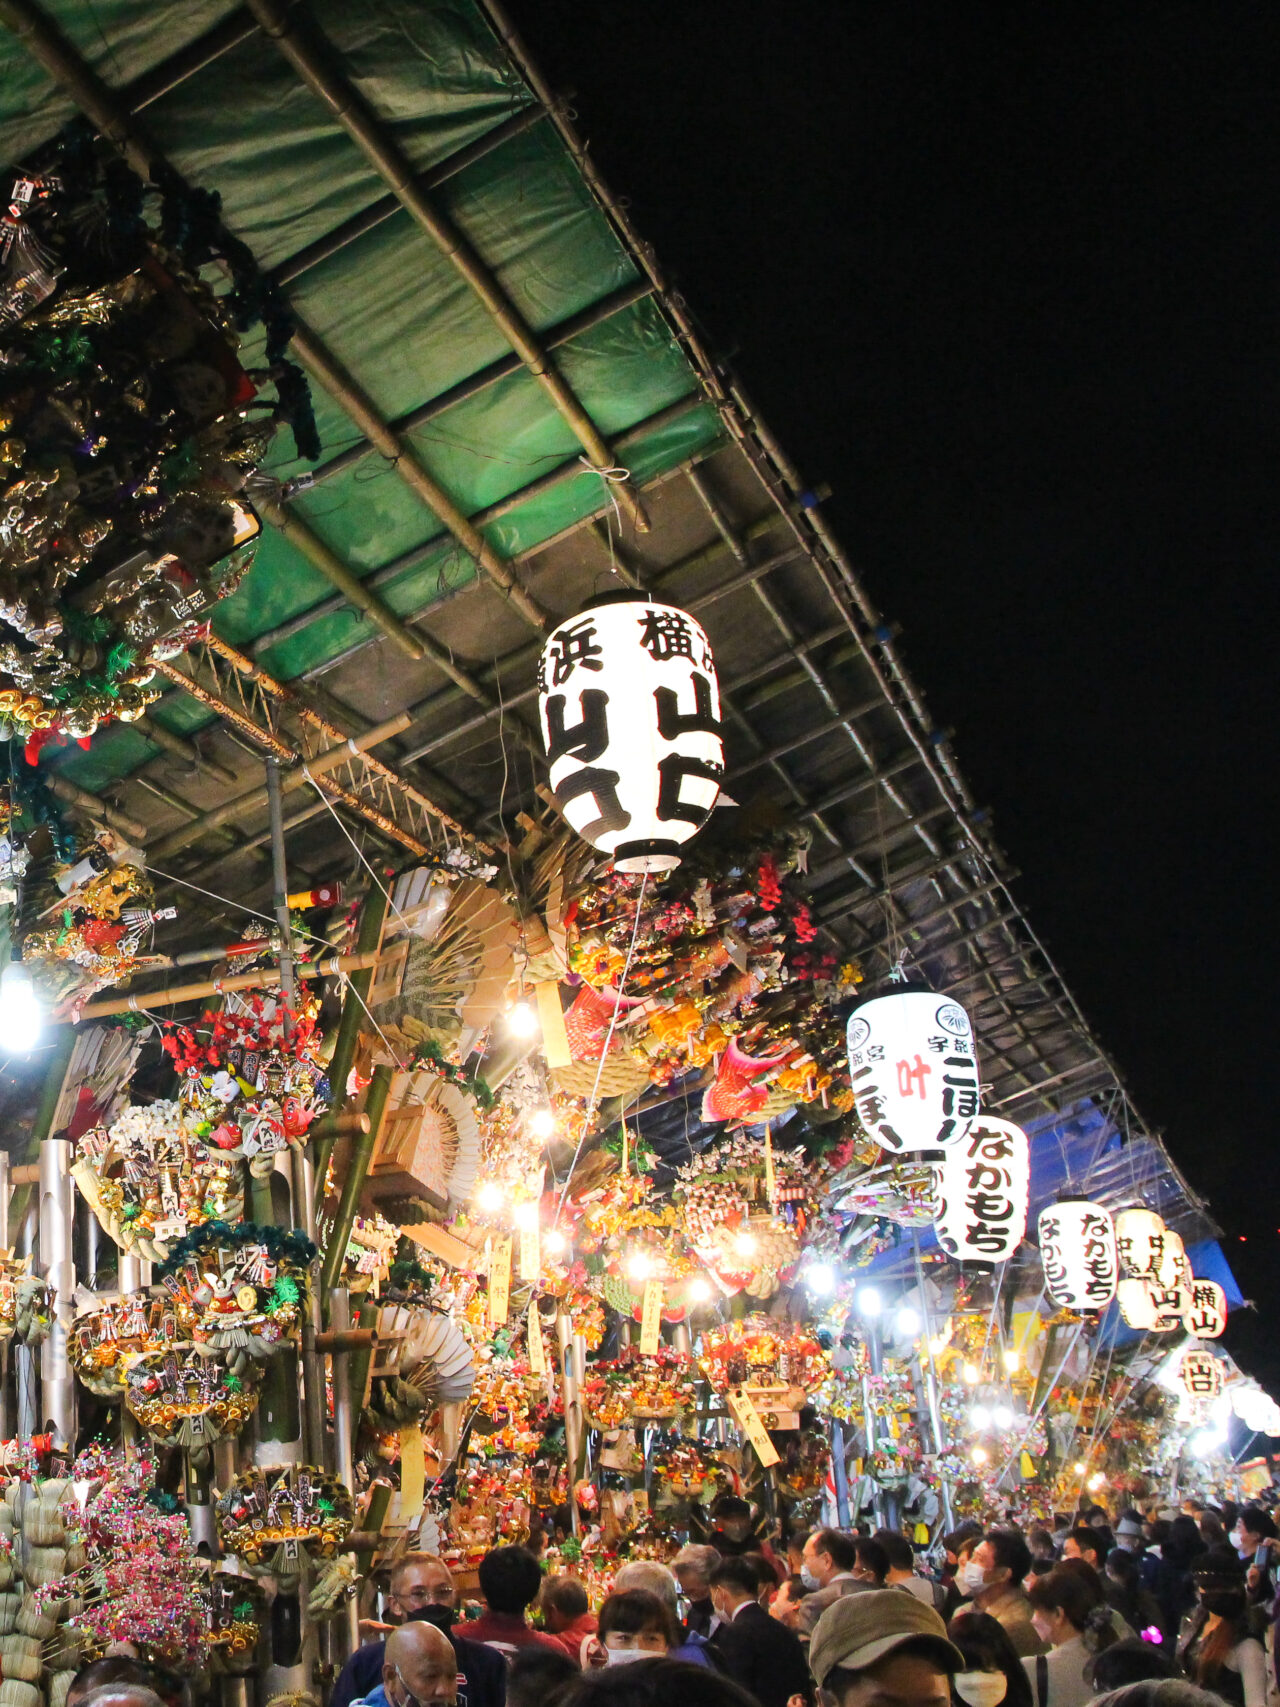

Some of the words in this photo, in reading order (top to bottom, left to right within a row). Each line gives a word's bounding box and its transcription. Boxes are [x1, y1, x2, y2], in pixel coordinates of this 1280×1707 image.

[964, 1125, 1014, 1254] なかもち
[1080, 1213, 1114, 1302] なかもち
[1191, 1285, 1219, 1333] 横山
